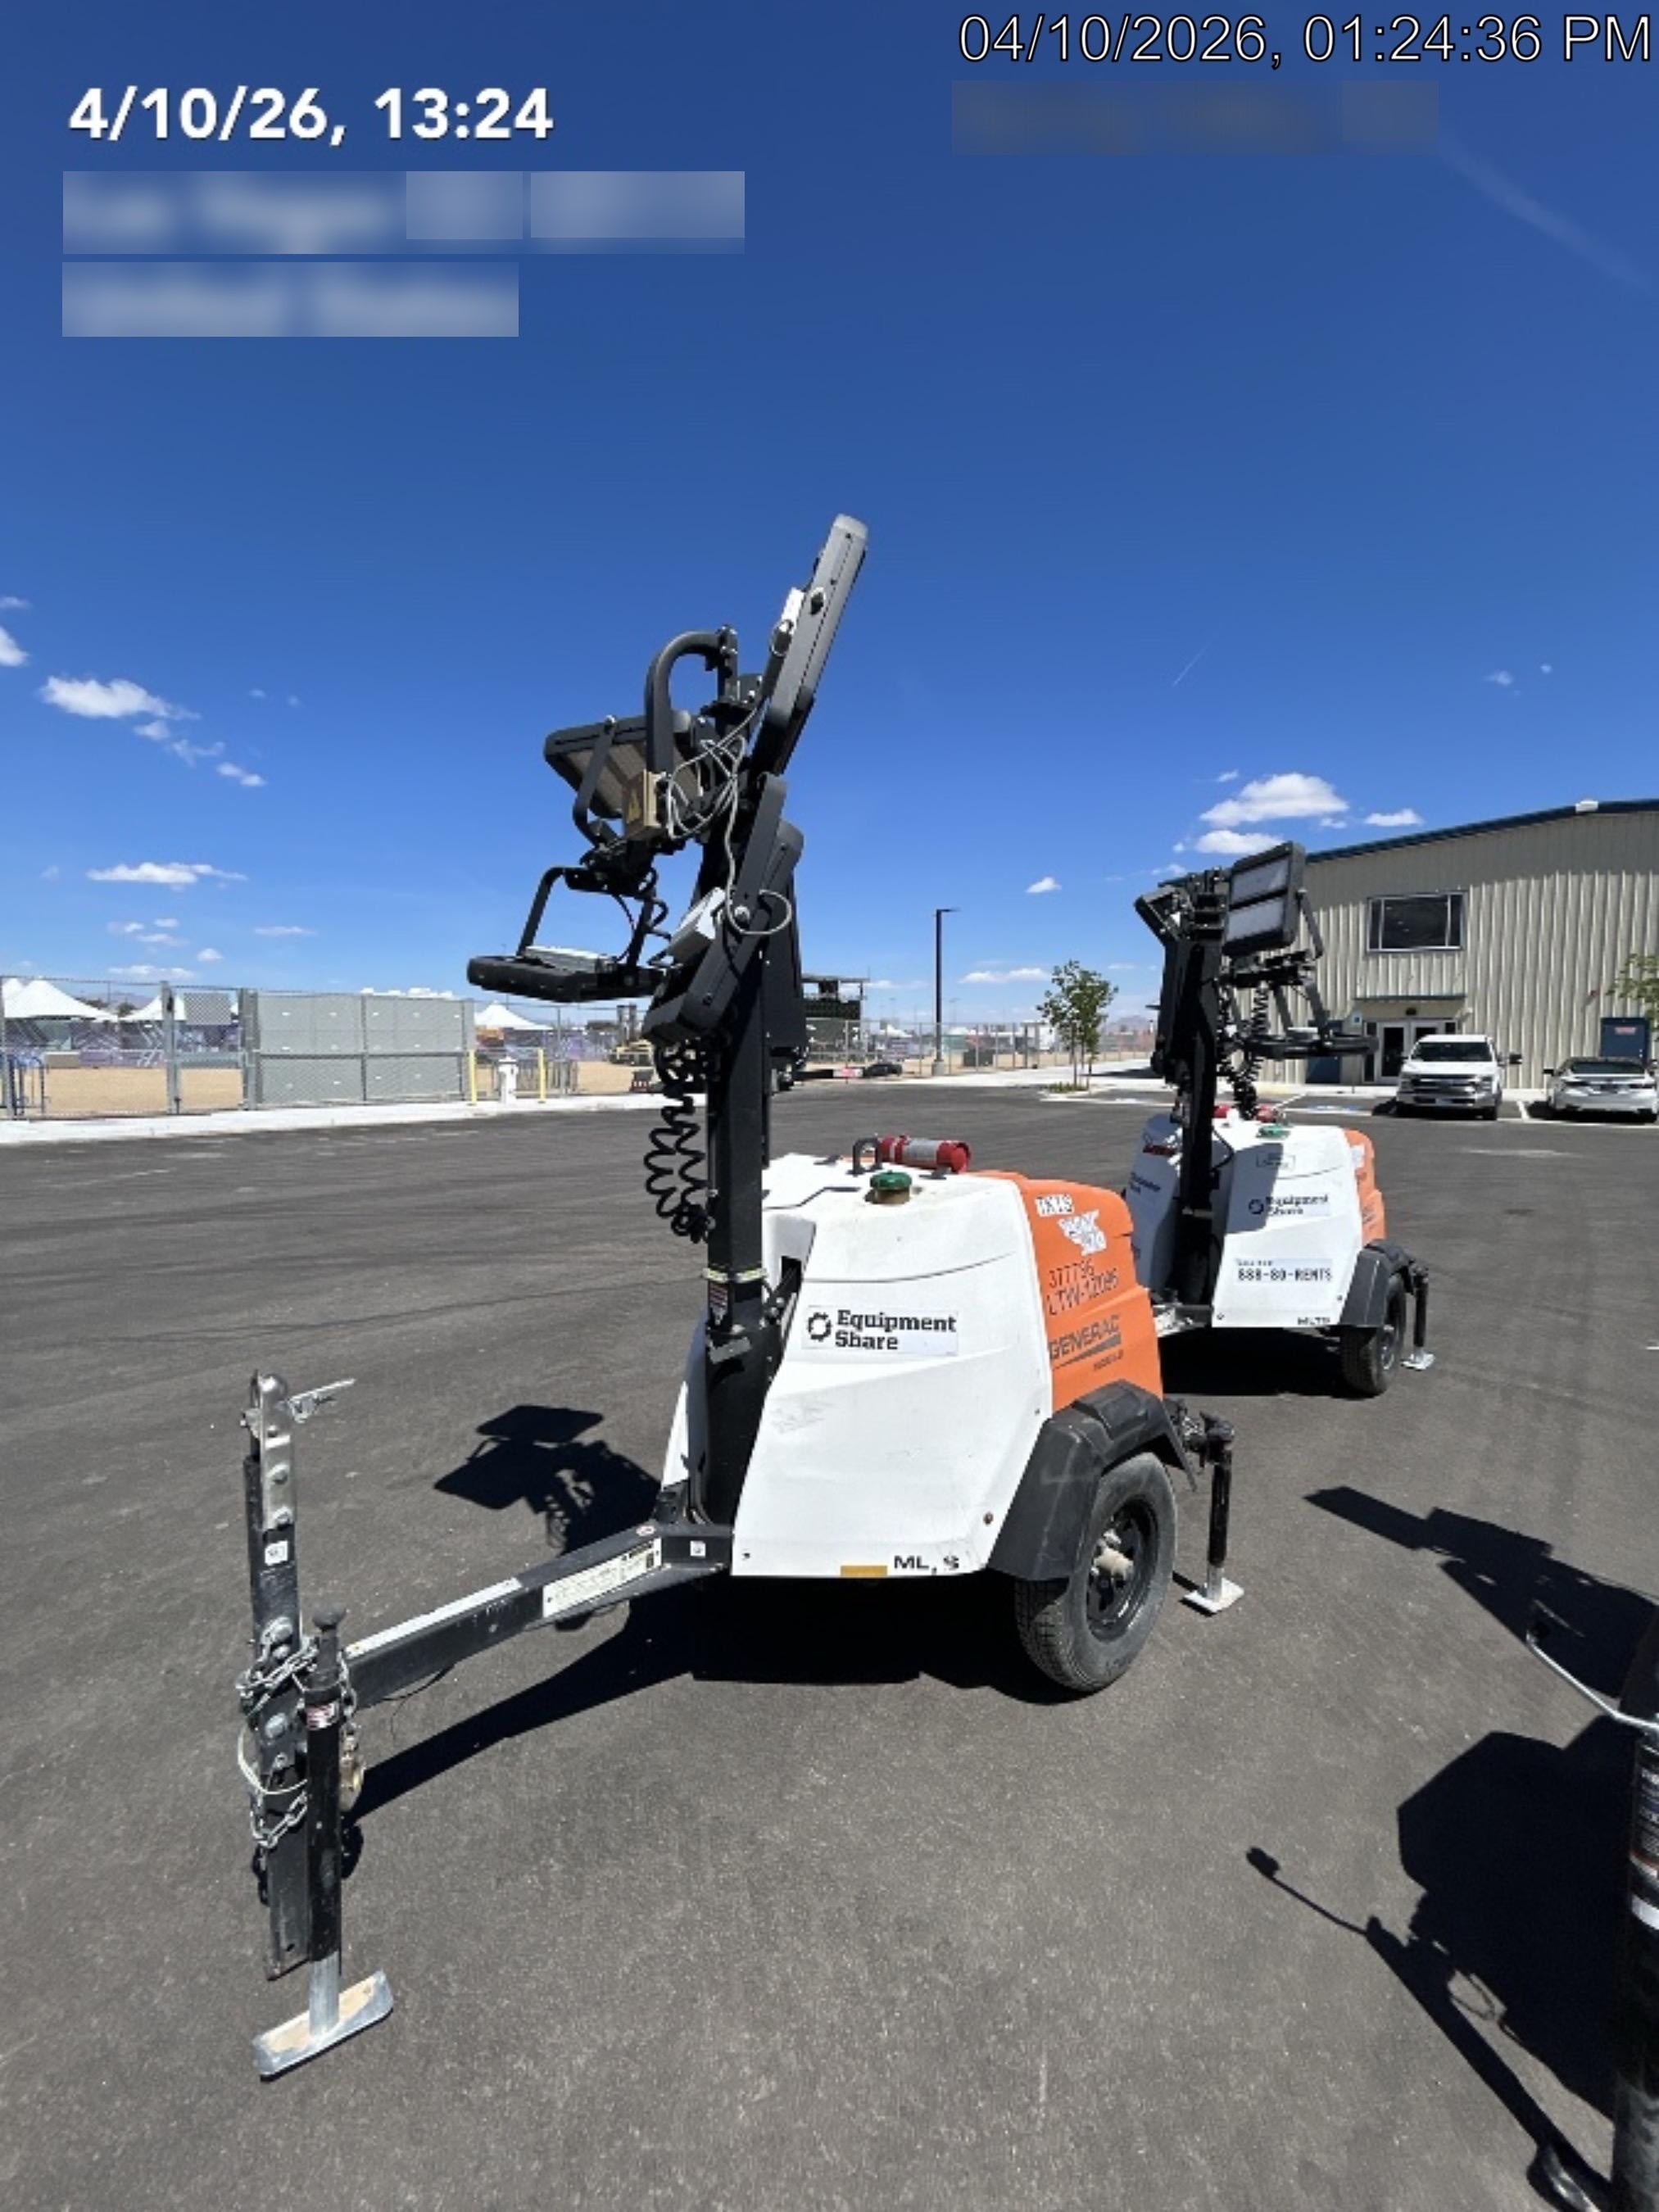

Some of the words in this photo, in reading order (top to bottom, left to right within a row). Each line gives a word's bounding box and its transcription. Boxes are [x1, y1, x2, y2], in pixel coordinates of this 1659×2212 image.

[836, 1309, 957, 1334] Equipment
[835, 1329, 898, 1350] Share
[1048, 1314, 1121, 1361] GENERAC
